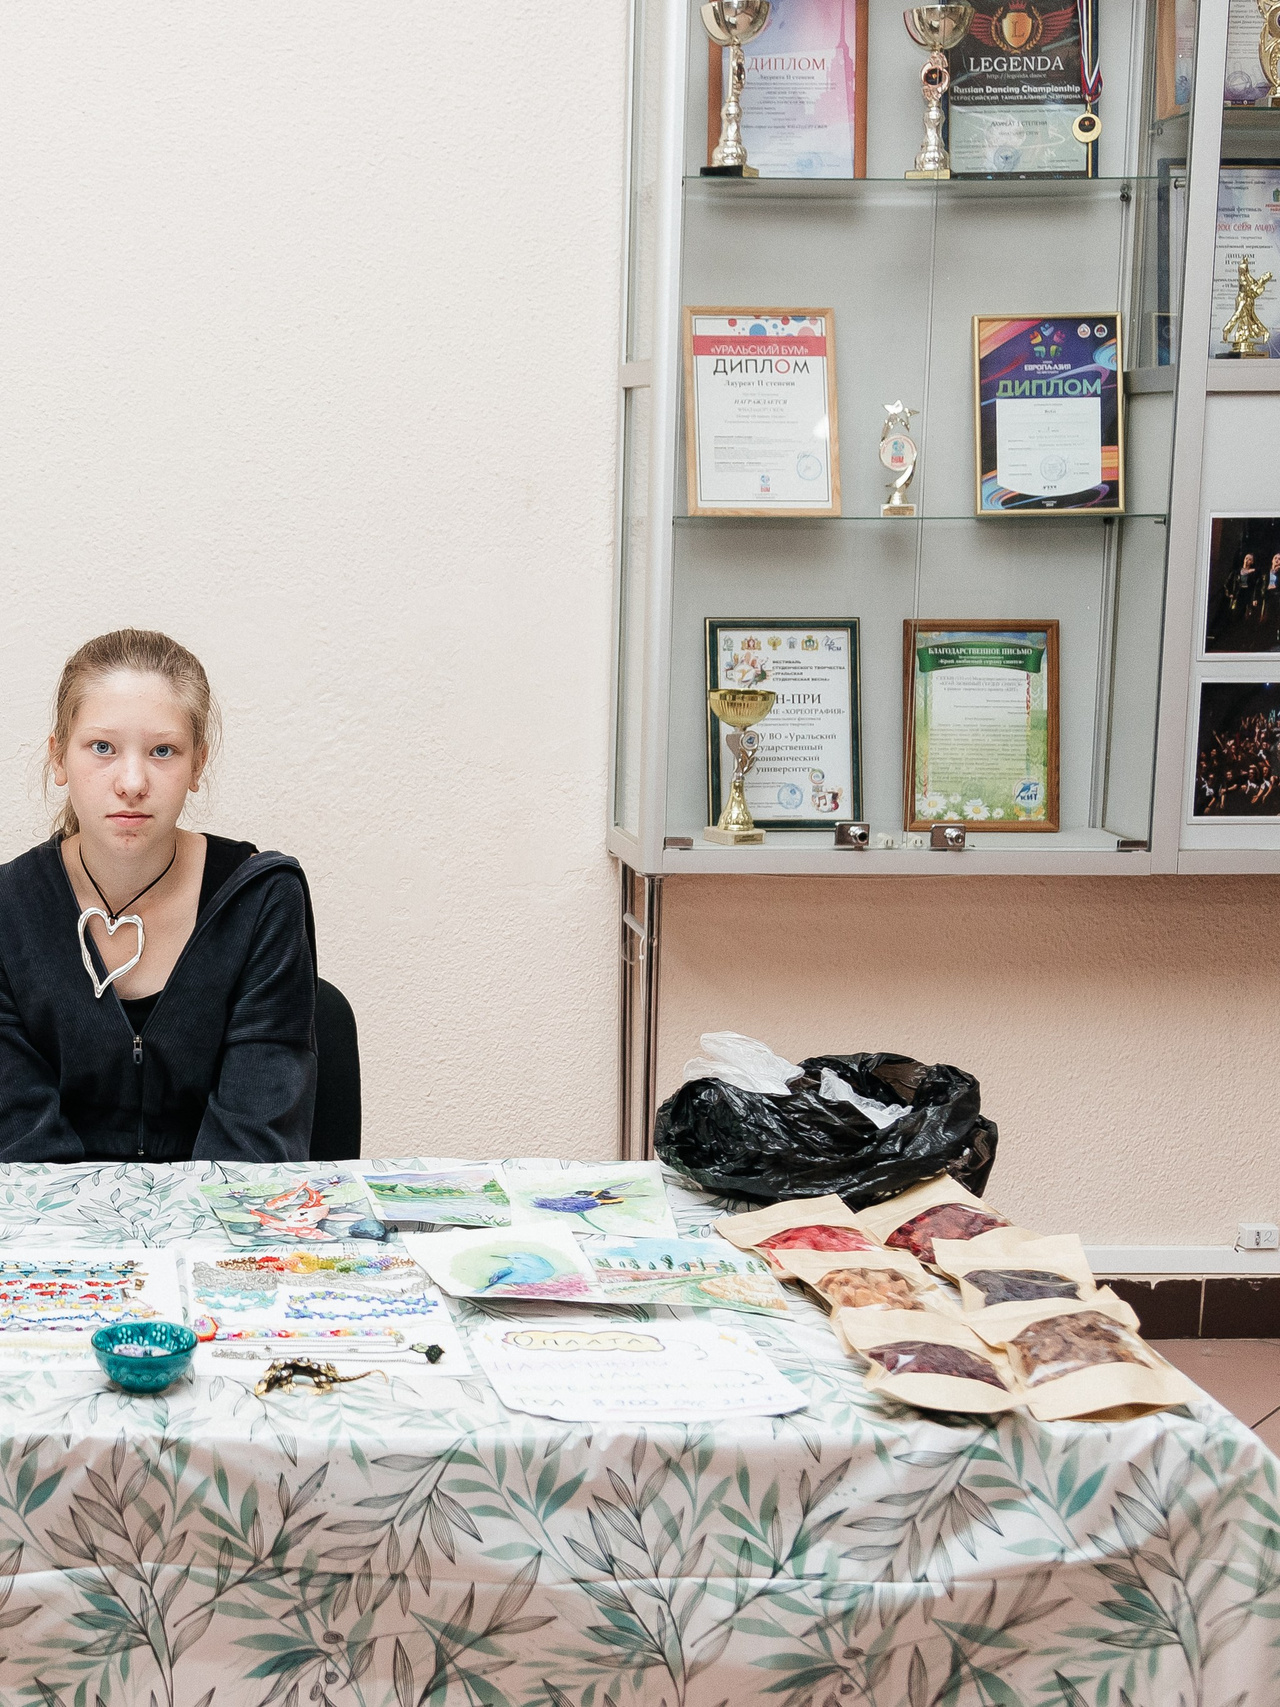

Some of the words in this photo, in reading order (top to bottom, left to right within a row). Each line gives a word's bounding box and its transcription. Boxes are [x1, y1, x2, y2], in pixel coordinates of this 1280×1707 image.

[747, 57, 826, 73] ДИПЛОМ
[970, 56, 1064, 72] LEGENDA
[953, 85, 984, 94] Russian
[986, 84, 1020, 96] Dancing
[1021, 84, 1081, 95] Championship
[710, 344, 780, 355] «УРАЛЬСКИЙ
[781, 346, 809, 356] БУМ»
[712, 358, 810, 376] ДИПЛОМ
[724, 380, 755, 388] Лауреат
[996, 379, 1101, 397] ДИПЛОМ
[928, 647, 1000, 655] БЛАГОДАРСТВЕННОЕ
[775, 693, 822, 704] Н-ПРИ
[784, 732, 837, 742] «Уральский
[757, 744, 823, 752] сударственный
[1263, 1230, 1276, 1243] 2
